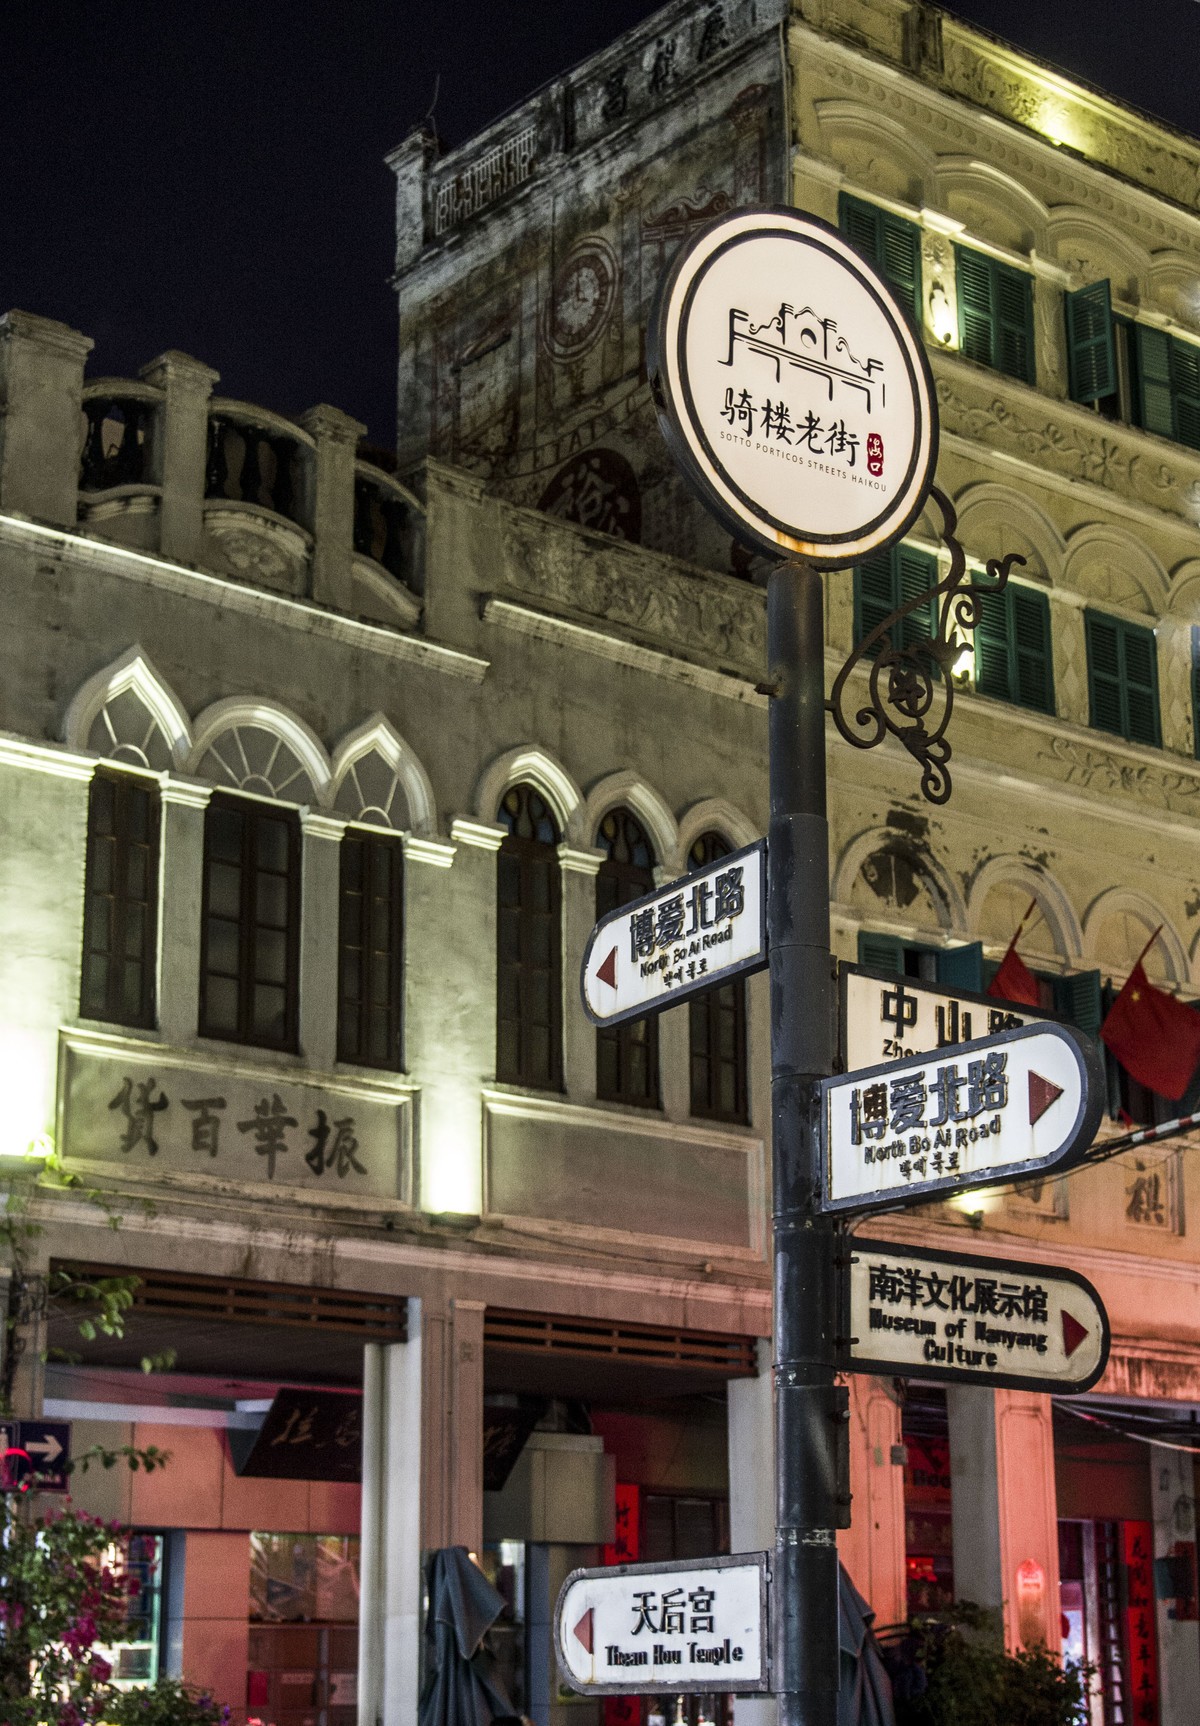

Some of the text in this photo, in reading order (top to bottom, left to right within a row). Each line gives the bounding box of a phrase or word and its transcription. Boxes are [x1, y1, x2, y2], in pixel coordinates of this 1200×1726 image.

[720, 387, 860, 467] 骑楼老街
[720, 431, 887, 492] SOTTO PORTICOS STREETS HAIKOU
[630, 866, 744, 962] 博爱北路
[640, 924, 733, 977] North Bo Ai Road
[883, 1039, 922, 1058] Zho
[850, 1052, 1008, 1145] 博爱北路
[864, 1115, 1001, 1164] North Bo Ai Road
[869, 1264, 1048, 1322] 南洋文化展示馆
[869, 1309, 1048, 1352] Museum of Nanyang
[923, 1339, 998, 1367] Culture
[630, 1586, 715, 1635] 天后宫
[653, 1644, 682, 1665] Hou
[687, 1639, 743, 1666] Temple
